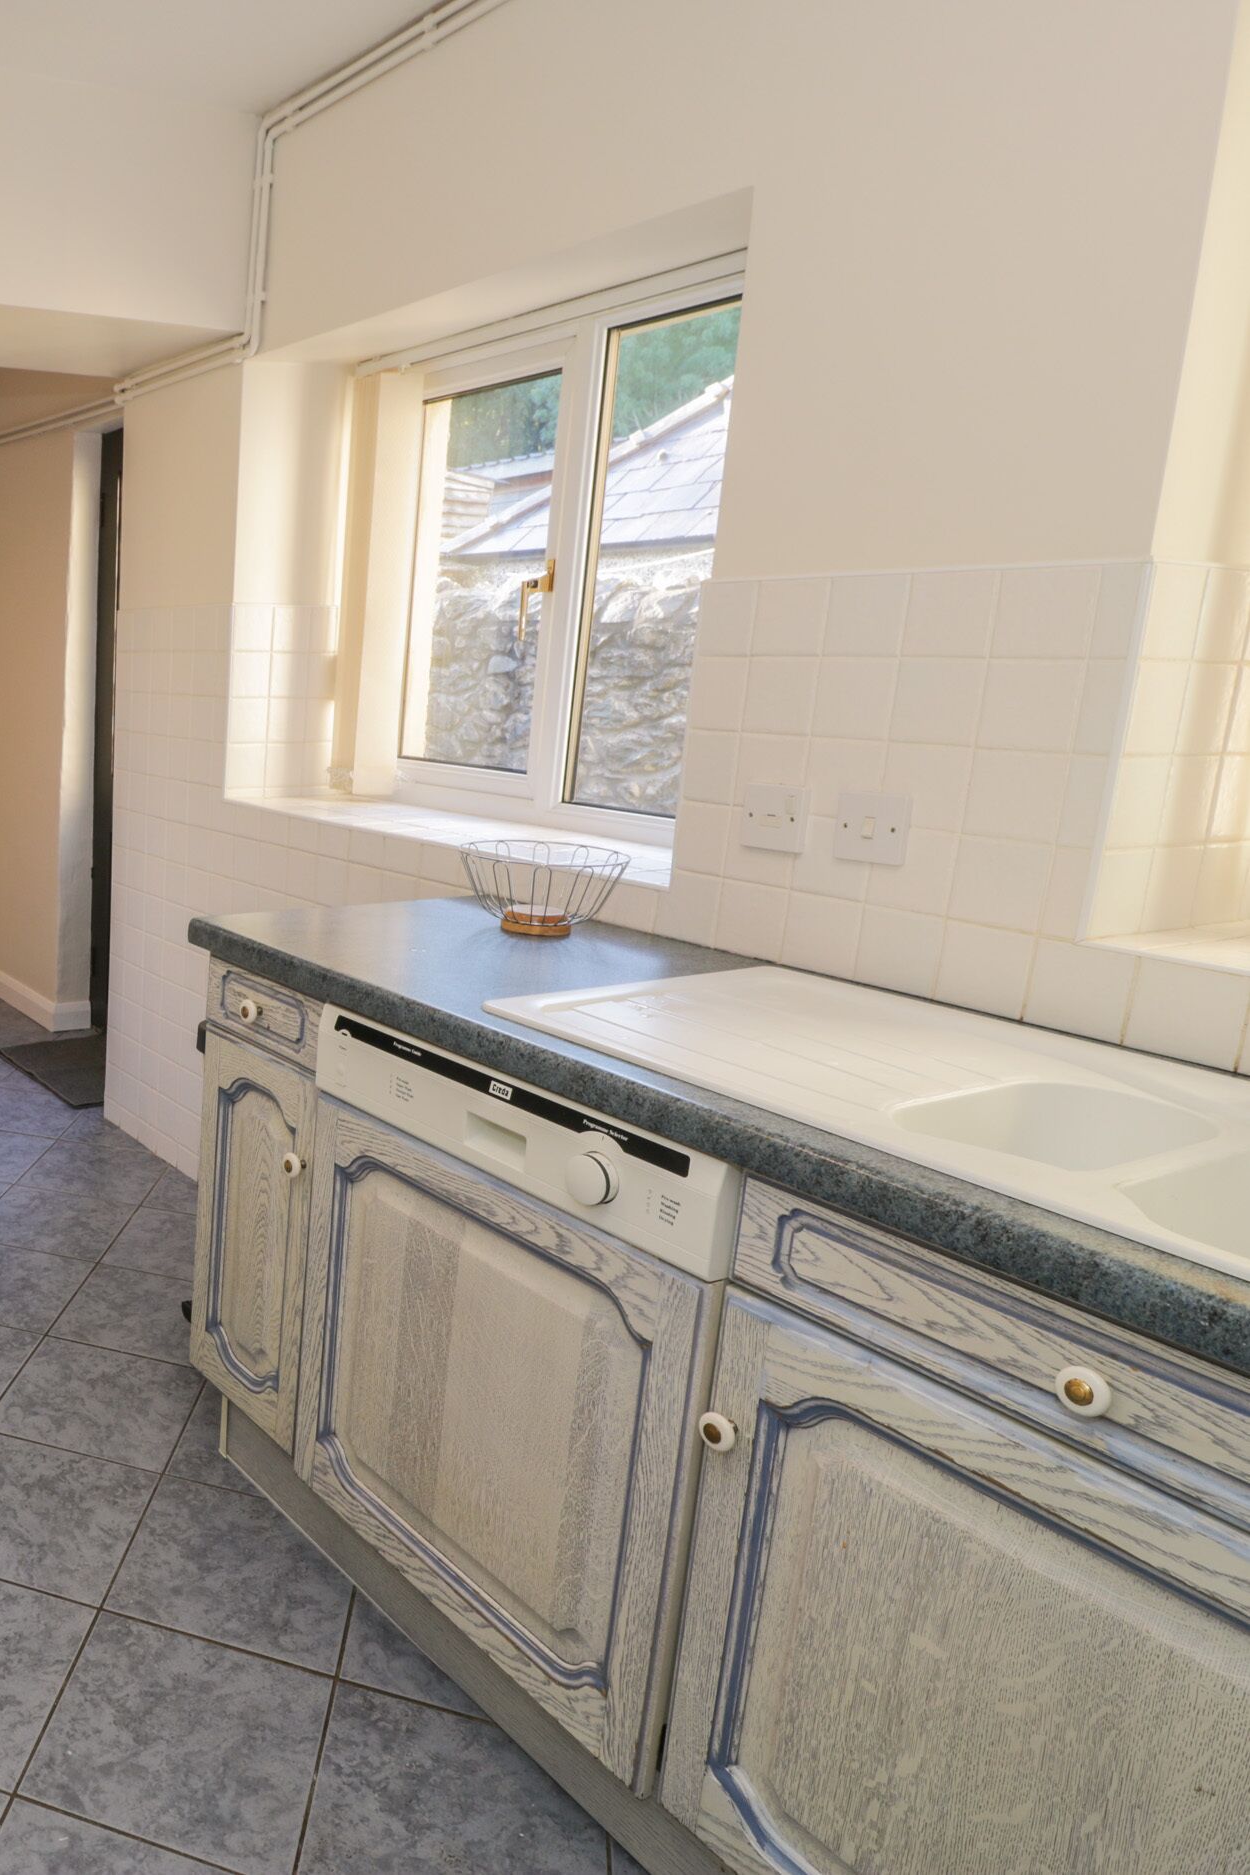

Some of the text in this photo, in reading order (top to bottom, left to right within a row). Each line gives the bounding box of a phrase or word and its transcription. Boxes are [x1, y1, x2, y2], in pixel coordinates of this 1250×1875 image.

[492, 1084, 509, 1096] Creda
[582, 1119, 628, 1141] Programme Selector
